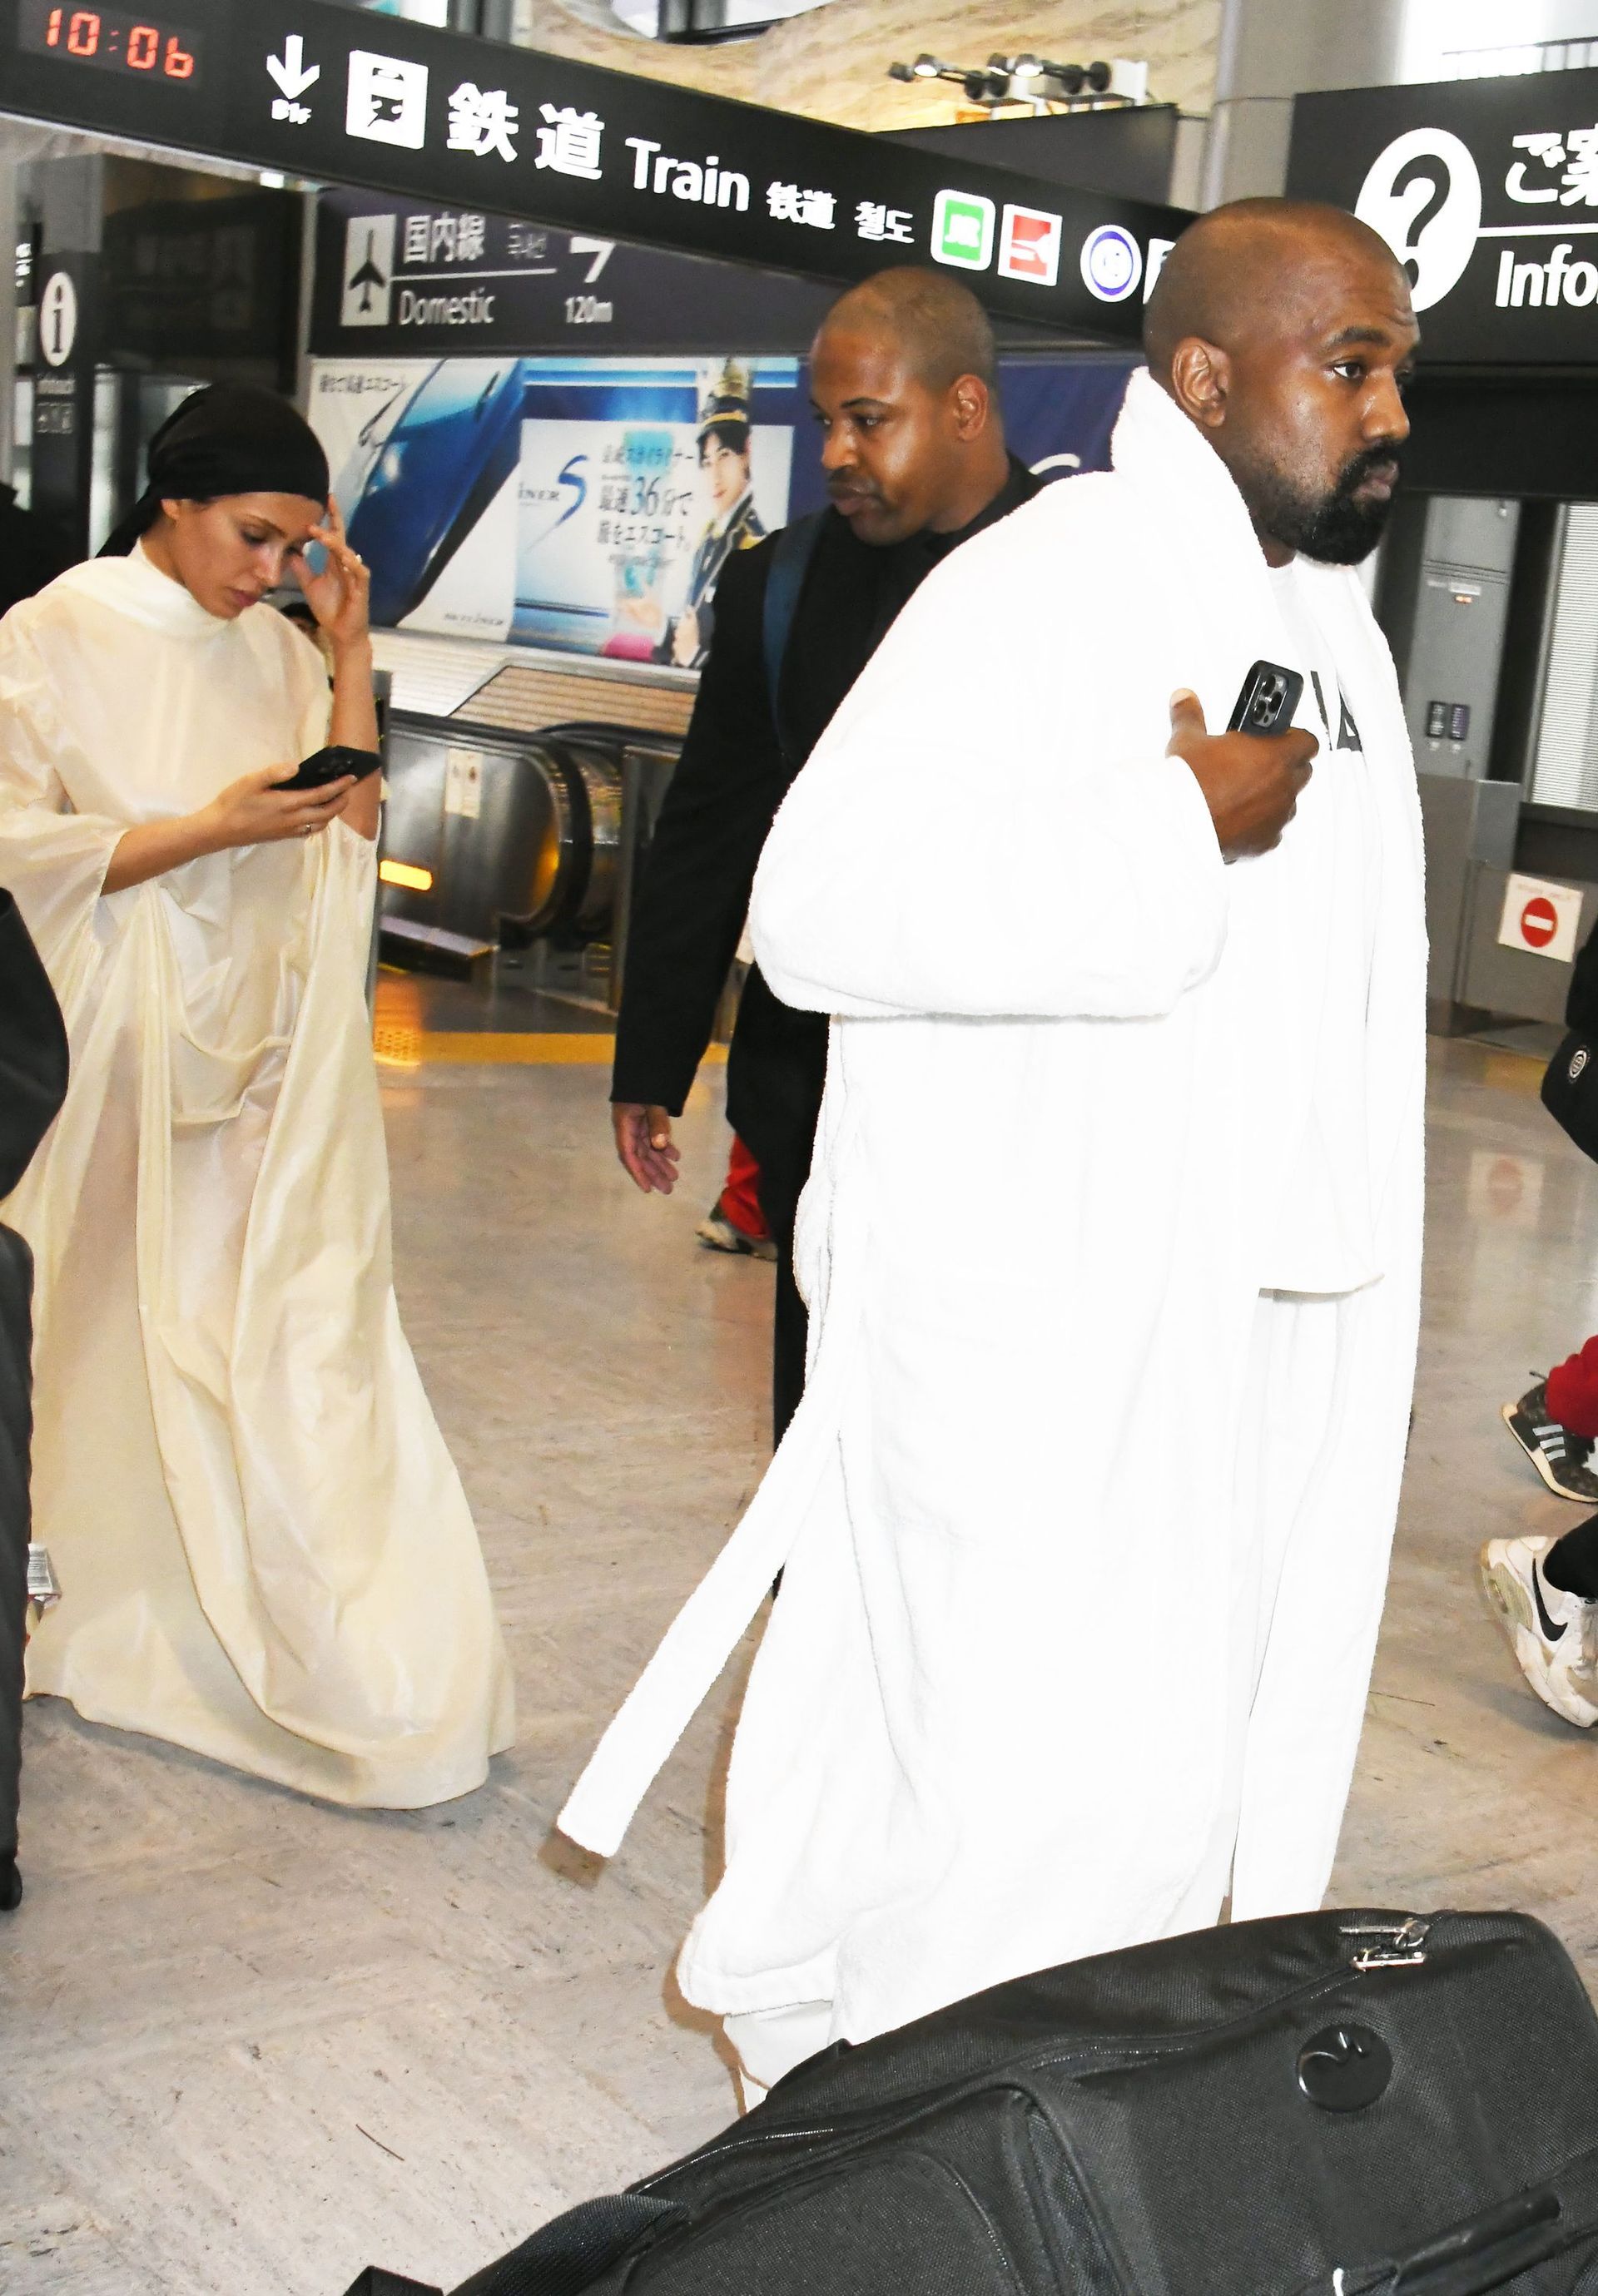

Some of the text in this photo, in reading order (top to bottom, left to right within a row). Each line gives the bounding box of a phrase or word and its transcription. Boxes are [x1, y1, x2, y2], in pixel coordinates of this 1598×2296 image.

[47, 10, 195, 79] 10:06
[446, 82, 605, 181] 鉄道
[624, 136, 751, 212] Train
[404, 211, 487, 264] 国内線
[569, 236, 617, 284] 7
[1495, 243, 1598, 308] Info
[400, 286, 497, 326] Domestic
[565, 295, 613, 325] 120m
